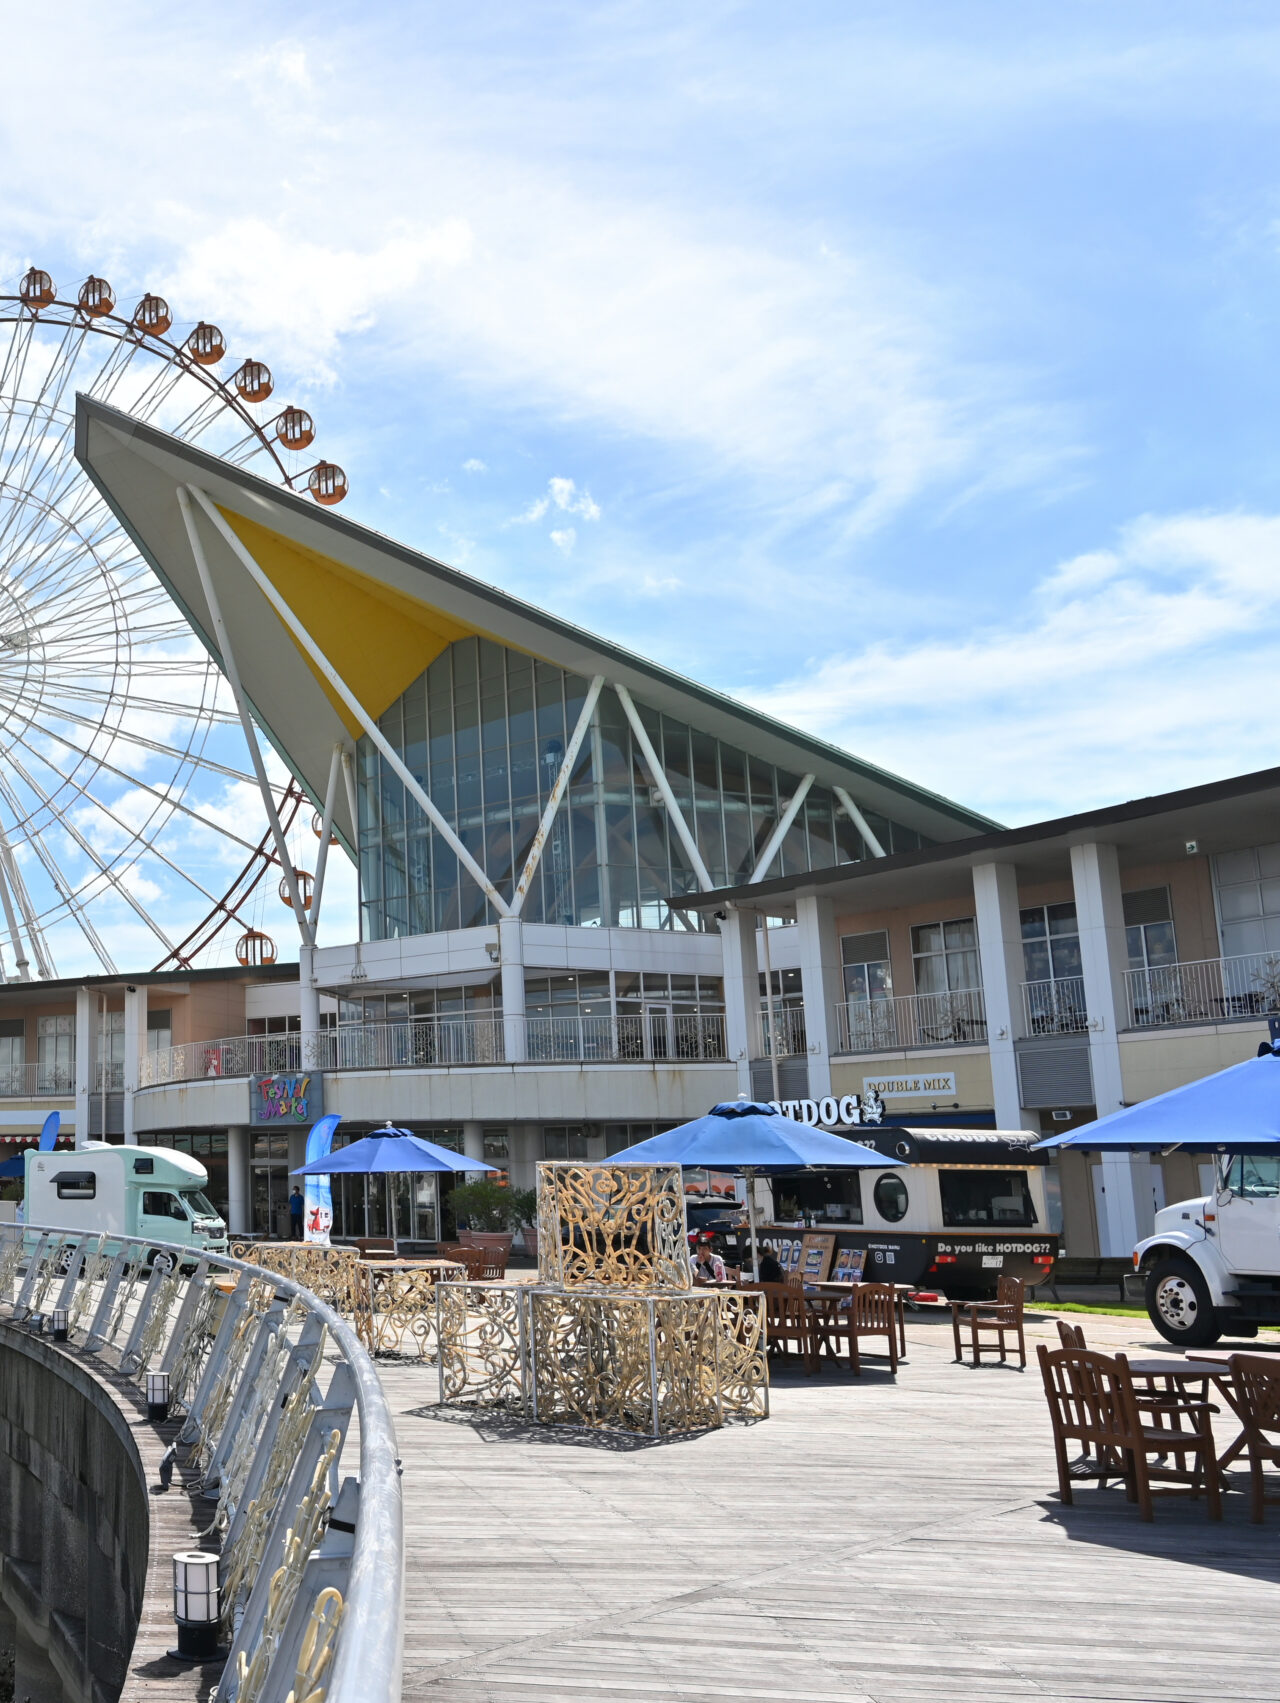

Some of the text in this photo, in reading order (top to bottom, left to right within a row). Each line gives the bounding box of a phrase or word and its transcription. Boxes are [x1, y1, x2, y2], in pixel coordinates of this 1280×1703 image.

[256, 1077, 311, 1101] Festival
[868, 1077, 952, 1093] DOUBLE MIX
[258, 1098, 308, 1122] Market
[937, 1242, 1051, 1254] Do you like HOTDOG??
